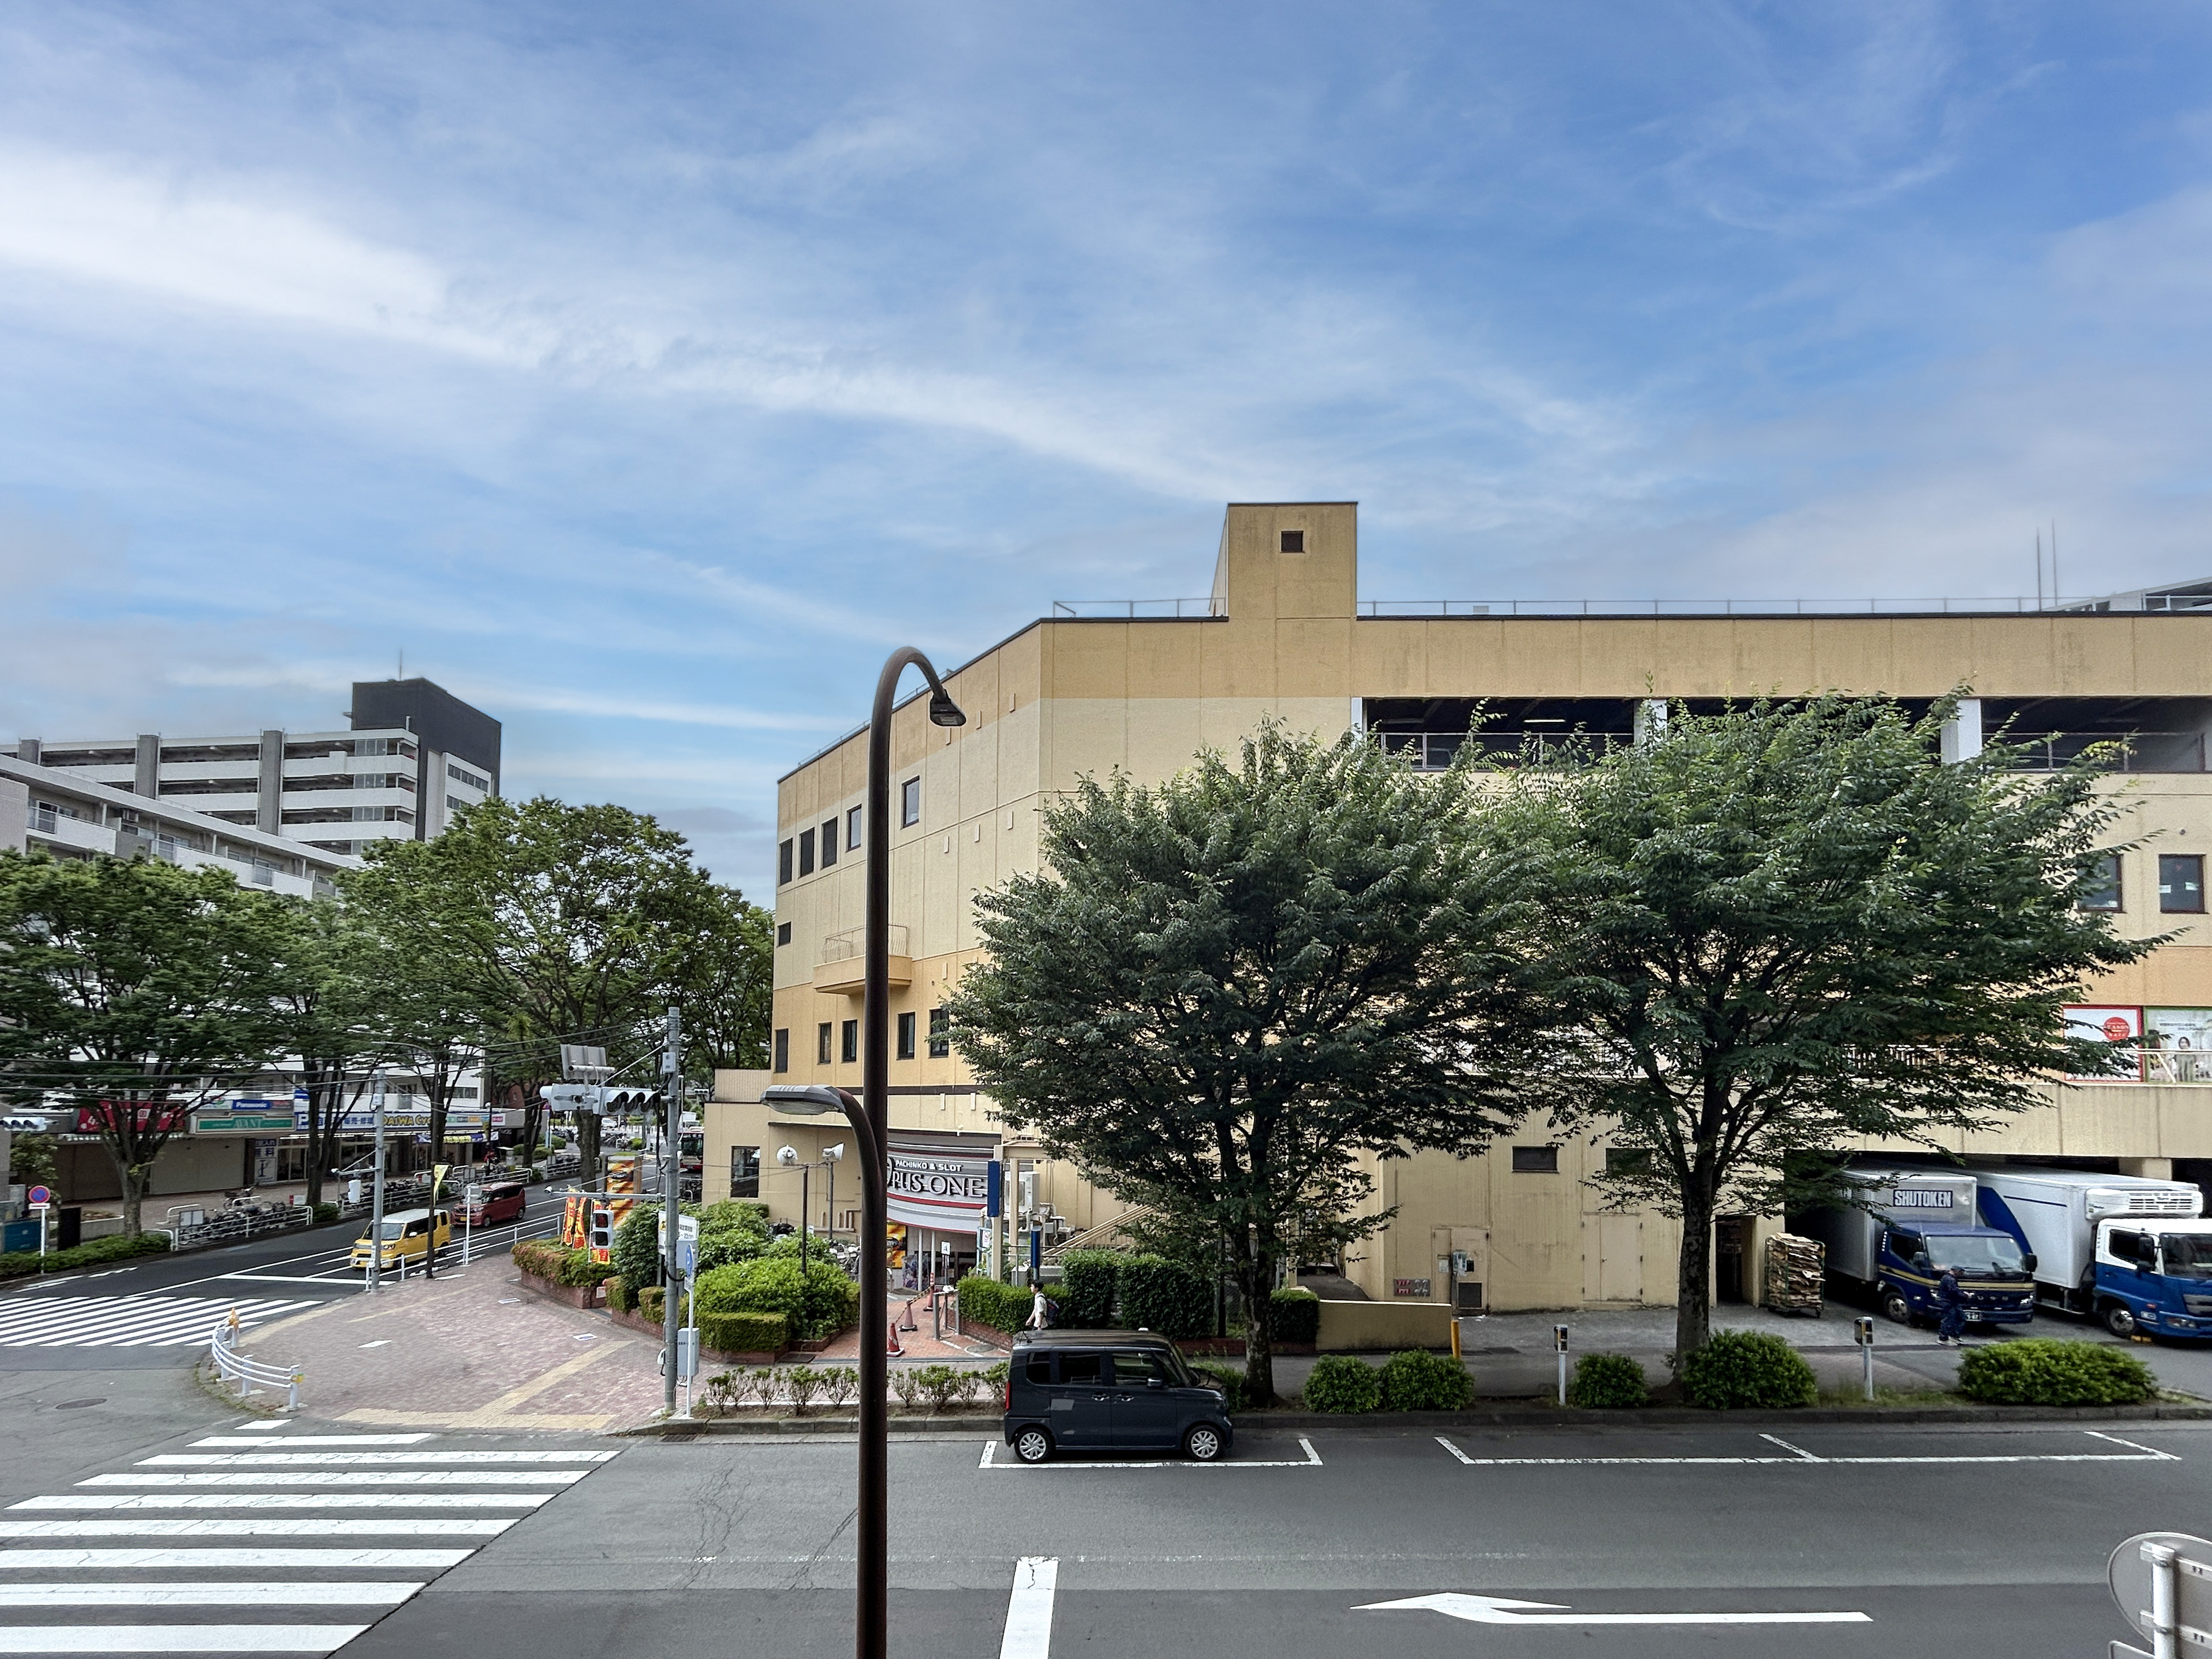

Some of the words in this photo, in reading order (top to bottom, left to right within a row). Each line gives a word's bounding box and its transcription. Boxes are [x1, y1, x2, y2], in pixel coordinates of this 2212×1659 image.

[895, 1159, 928, 1170] PACHINKO
[938, 1164, 962, 1172] SLOT
[928, 1175, 984, 1198] ONE
[1894, 1190, 1951, 1207] SHUTOKEN
